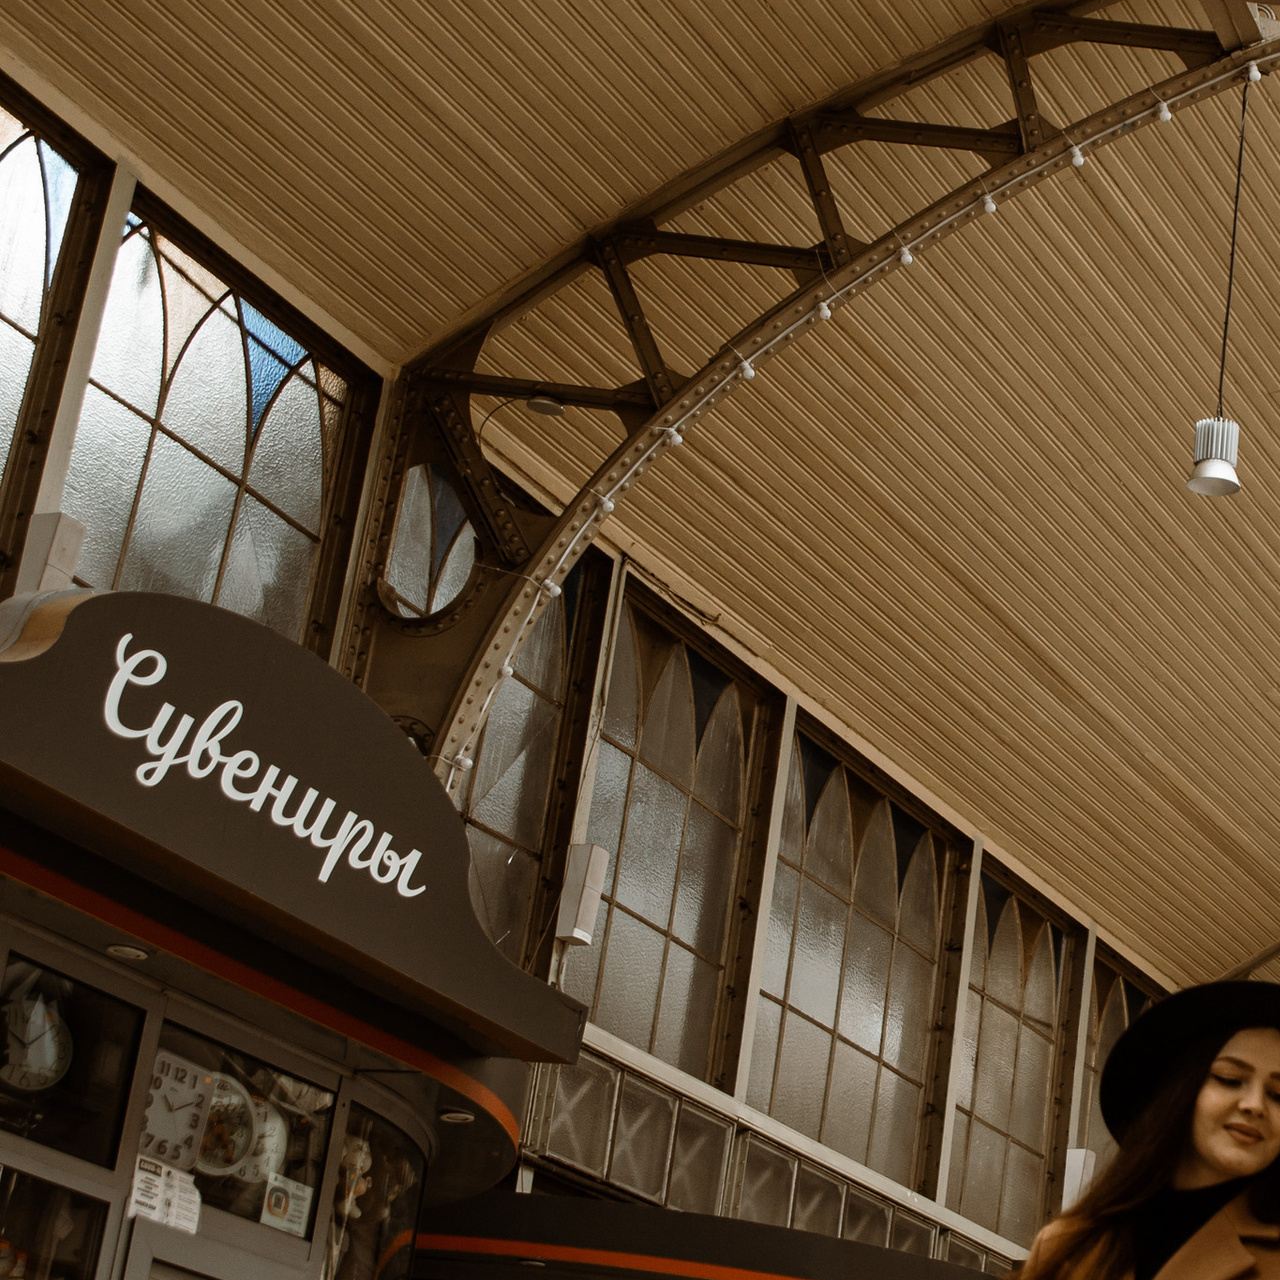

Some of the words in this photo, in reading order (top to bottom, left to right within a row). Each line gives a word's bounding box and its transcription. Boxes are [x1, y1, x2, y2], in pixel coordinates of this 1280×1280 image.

[104, 632, 426, 897] Сувениры
[160, 1060, 171, 1076] 11
[174, 1067, 188, 1084] 12
[151, 1076, 163, 1090] 0
[192, 1075, 198, 1089] 1
[194, 1093, 205, 1109] 2
[189, 1113, 200, 1129] 3
[145, 1132, 155, 1148] 7
[157, 1139, 169, 1155] 6
[184, 1135, 194, 1150] 4
[171, 1143, 183, 1160] 5
[239, 1165, 247, 1177] 6
